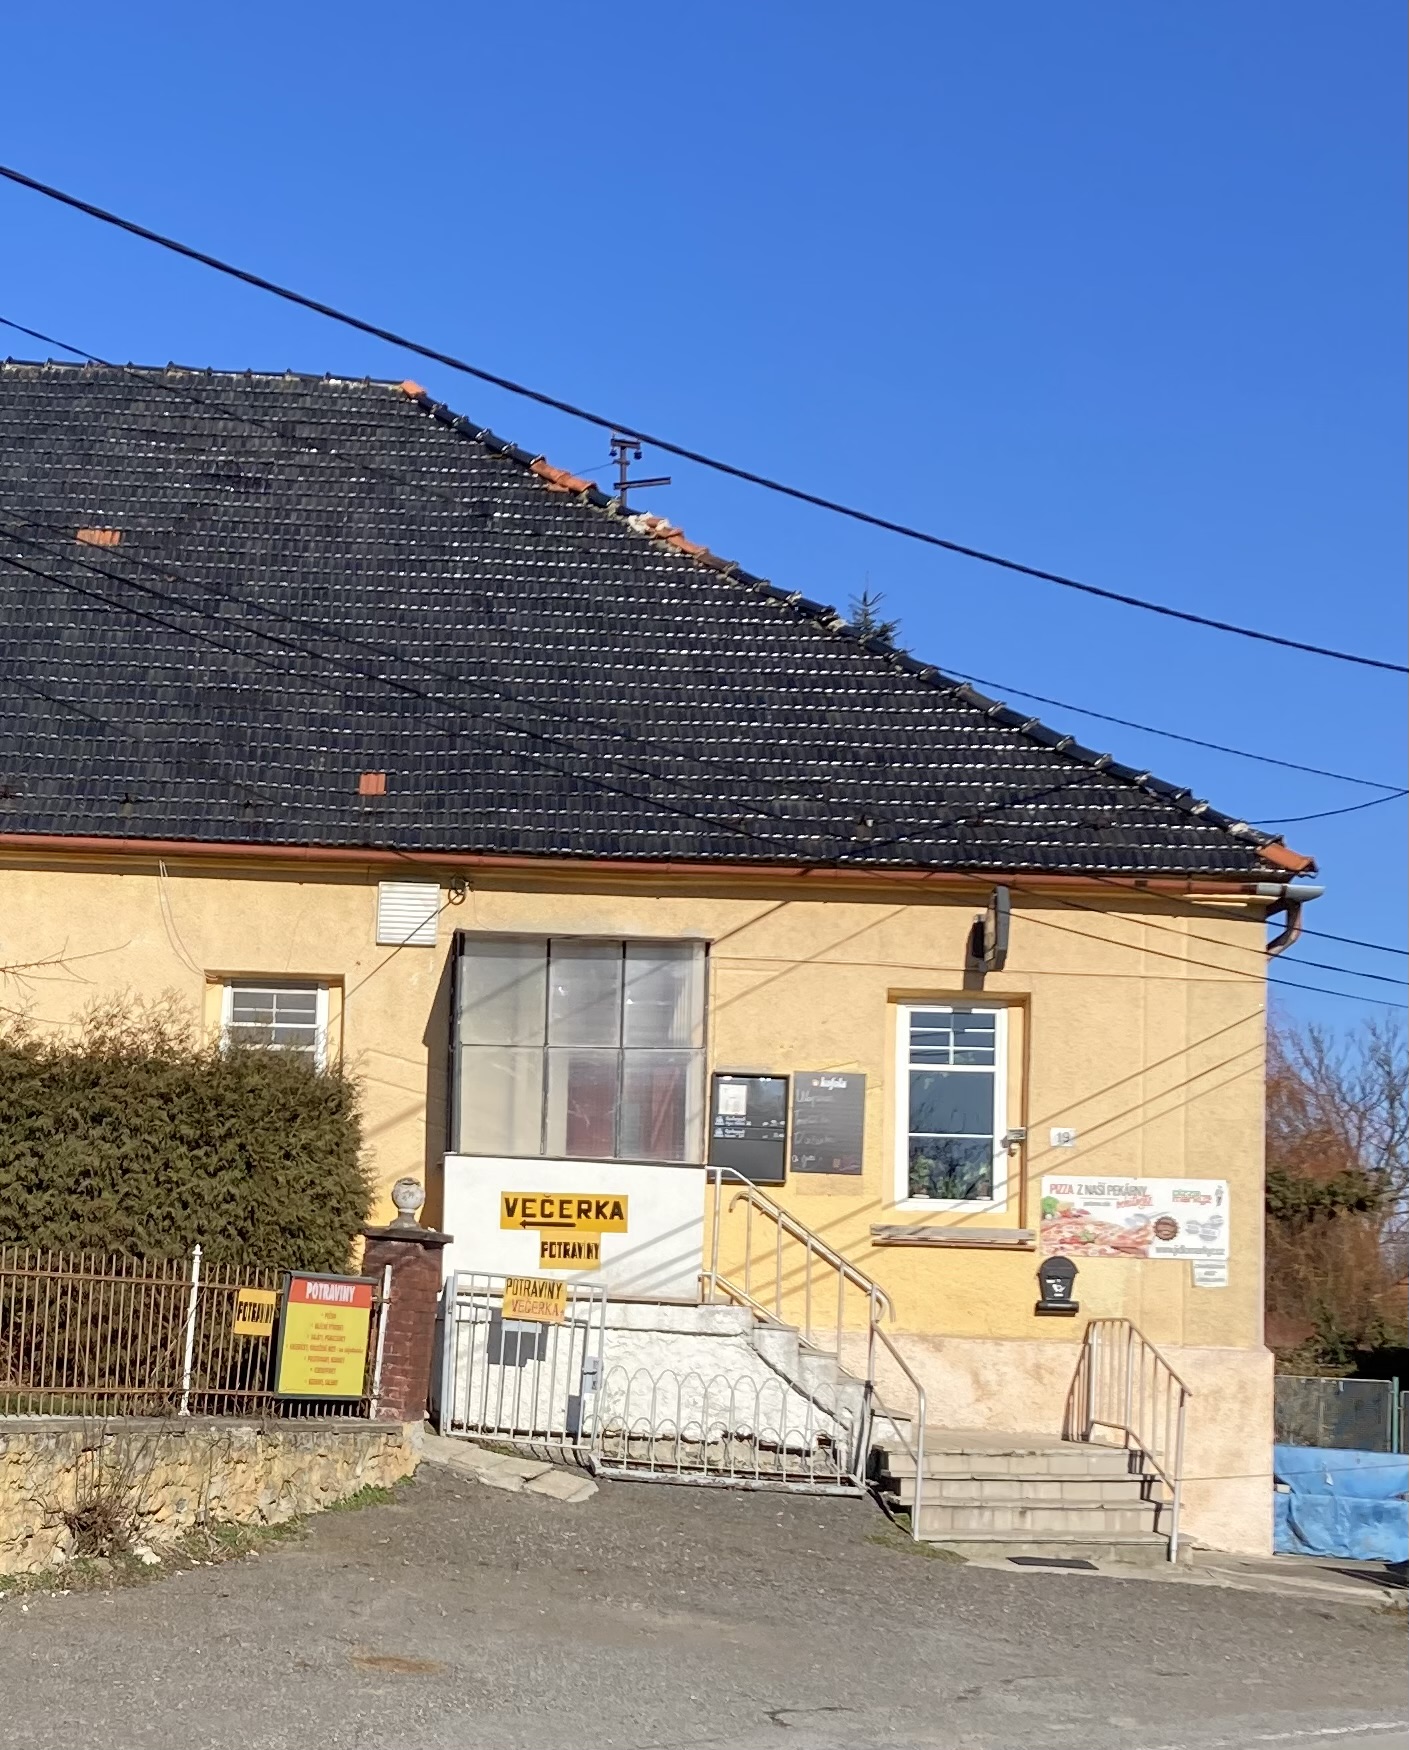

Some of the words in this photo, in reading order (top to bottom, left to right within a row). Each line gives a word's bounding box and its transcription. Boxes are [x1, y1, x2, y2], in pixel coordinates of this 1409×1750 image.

[1050, 1184, 1074, 1195] PIZZA
[1077, 1184, 1084, 1195] Z
[504, 1194, 625, 1220] VEČERKA
[540, 1241, 600, 1259] POTRAVINY
[305, 1281, 356, 1303] POTRAVINY
[506, 1278, 562, 1300] POTRAVINY
[511, 1297, 559, 1316] VEČERKA
